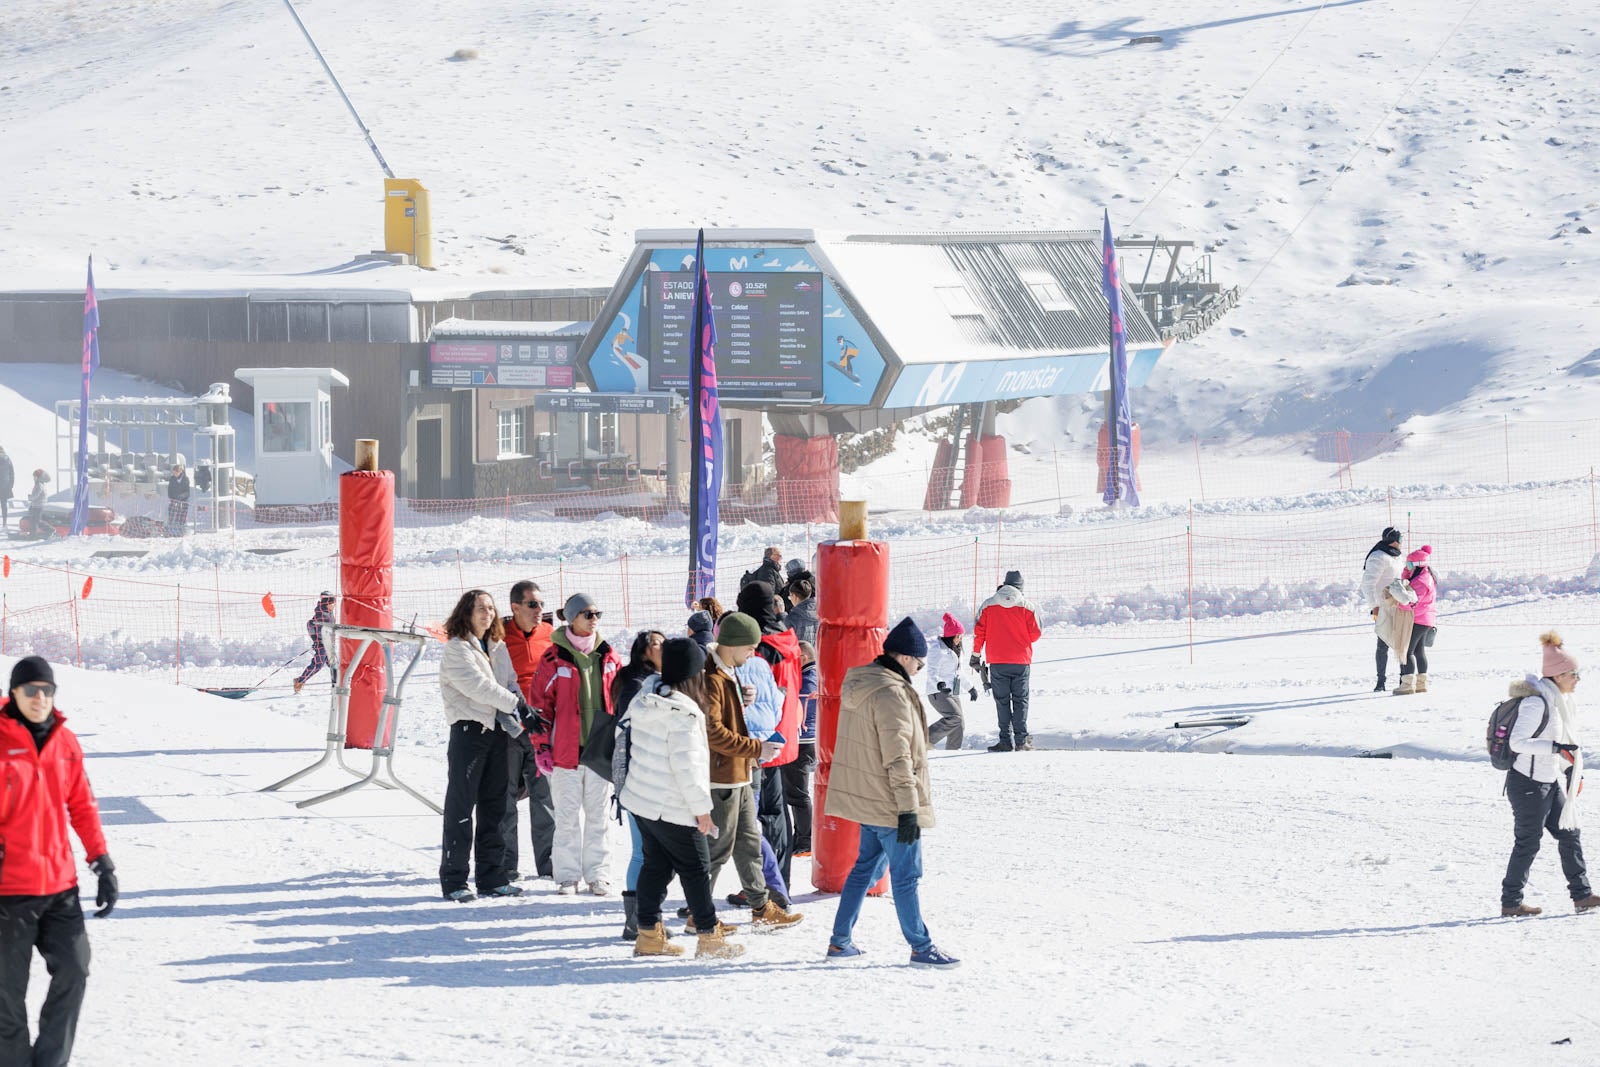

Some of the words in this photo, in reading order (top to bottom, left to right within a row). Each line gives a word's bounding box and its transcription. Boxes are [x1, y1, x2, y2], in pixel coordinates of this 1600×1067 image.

[663, 281, 693, 289] ESTADO
[663, 292, 673, 300] LA
[996, 364, 1064, 393] movistar
